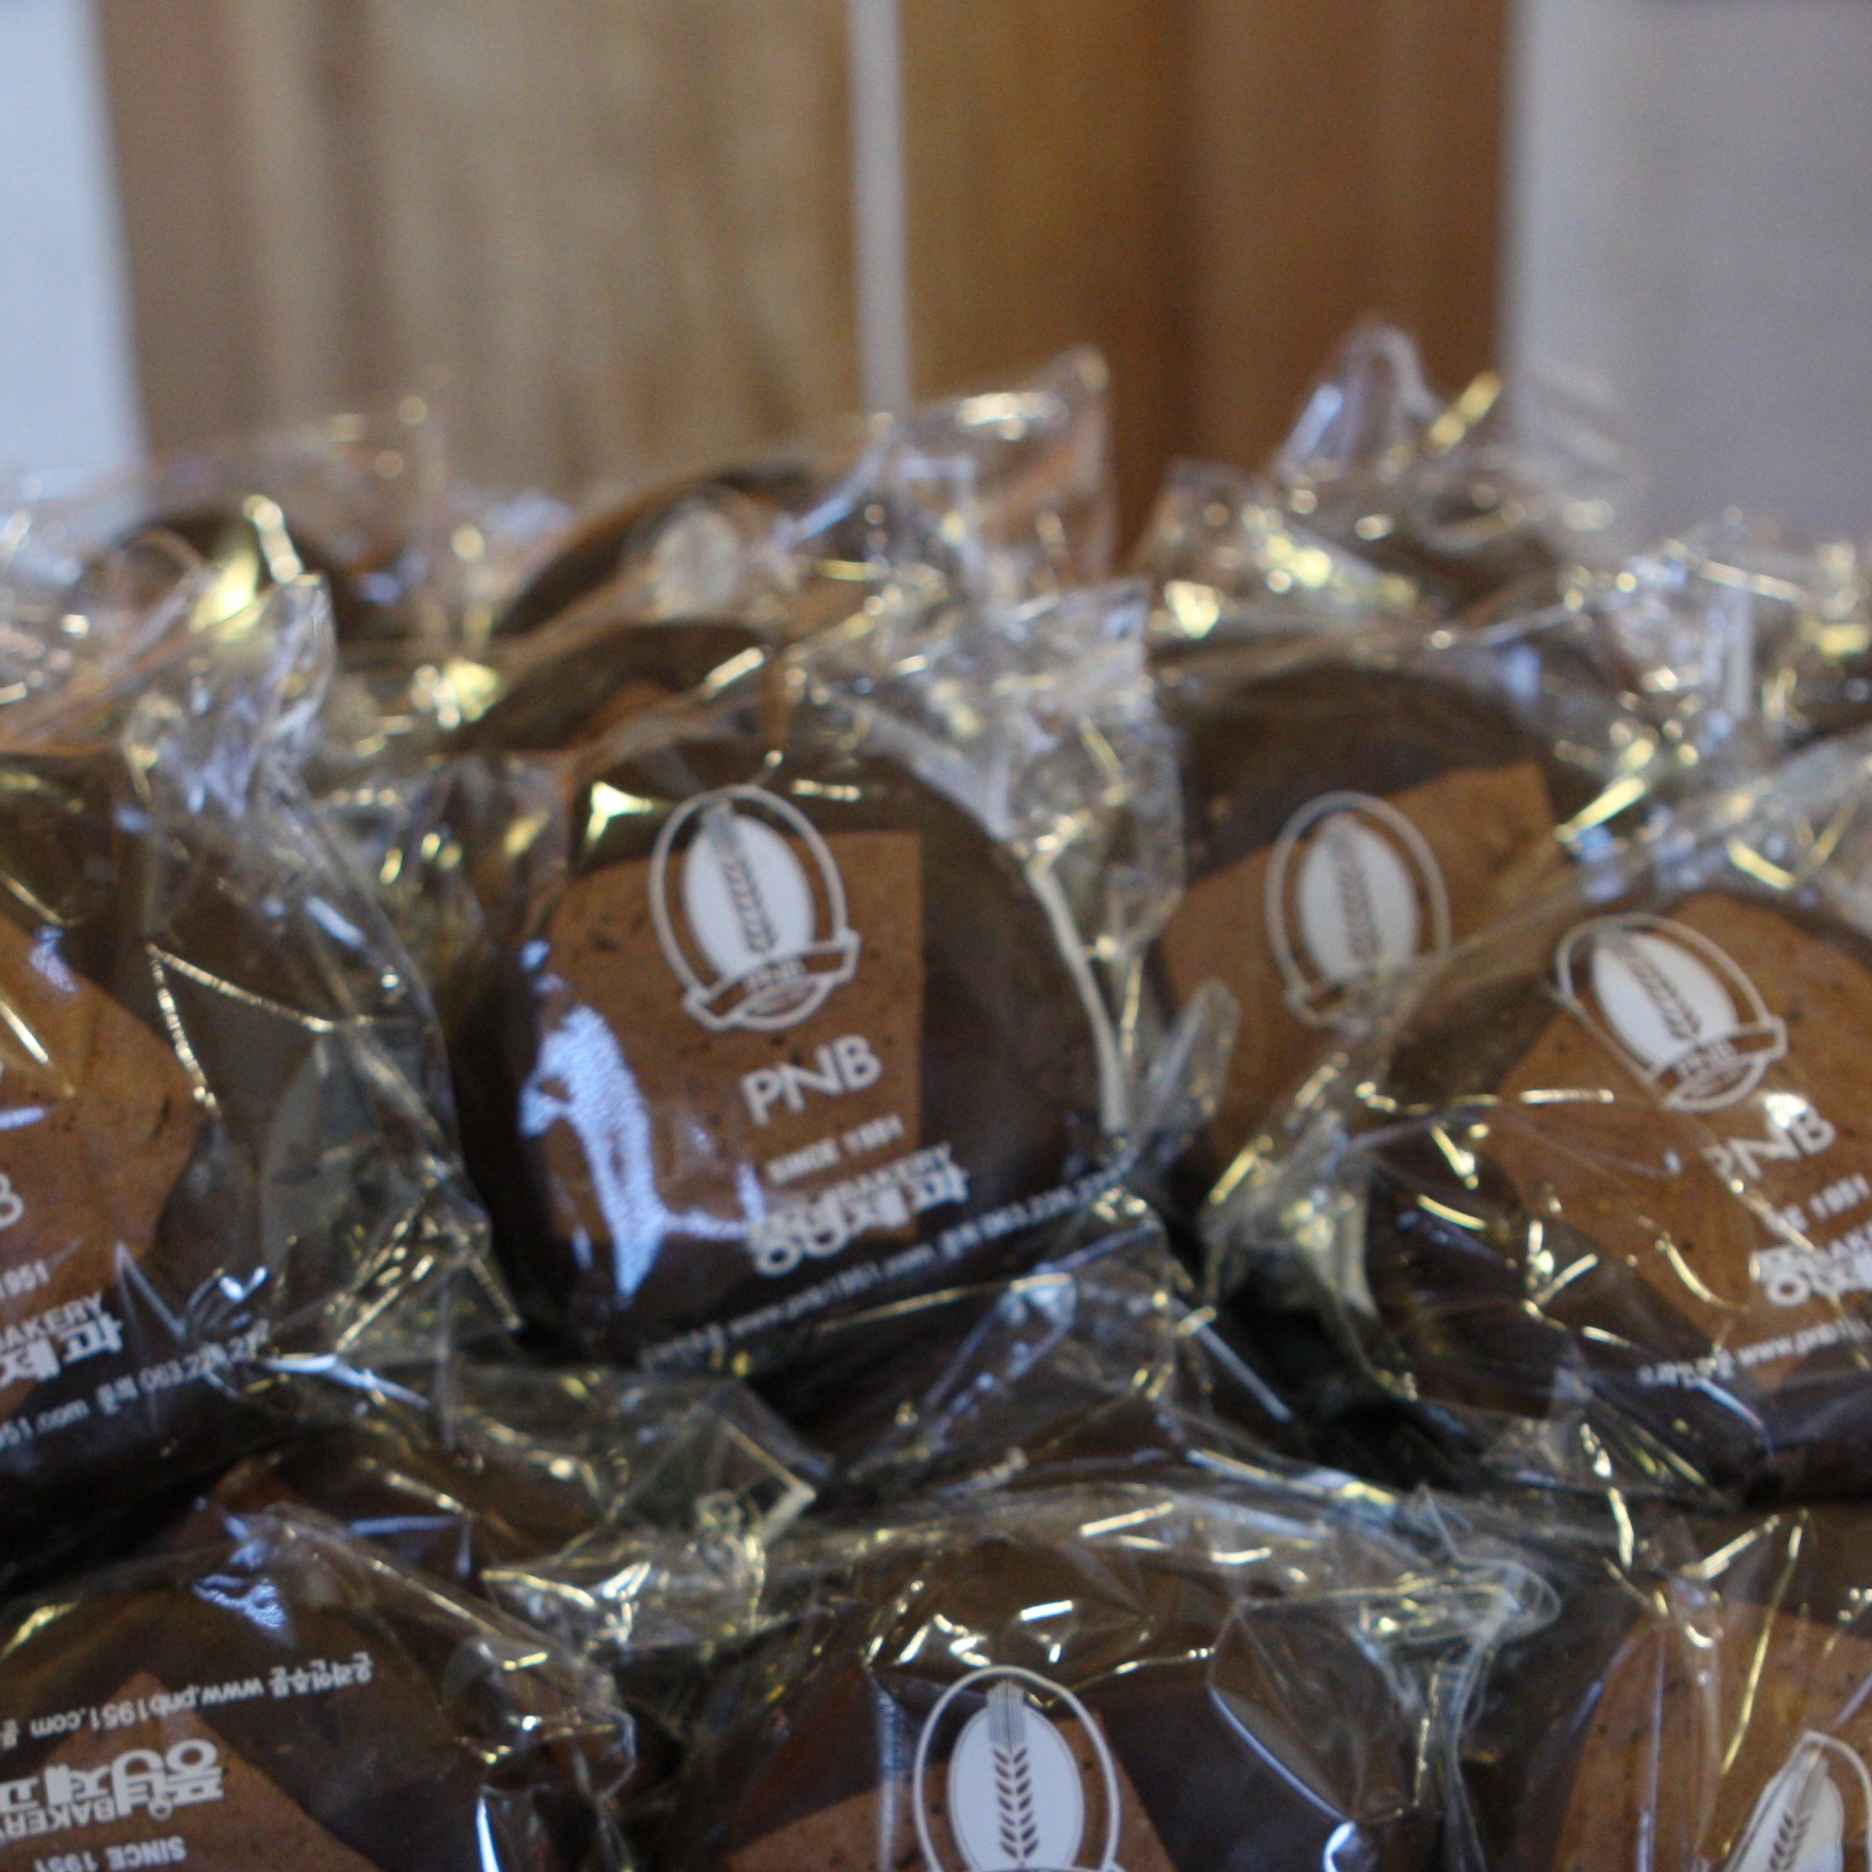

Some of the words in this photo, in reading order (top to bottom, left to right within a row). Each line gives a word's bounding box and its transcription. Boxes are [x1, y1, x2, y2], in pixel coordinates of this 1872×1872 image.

[741, 1035, 882, 1126] PNB
[30, 1675, 262, 1736] www.pnb1951.com
[106, 1834, 186, 1871] SINCE
